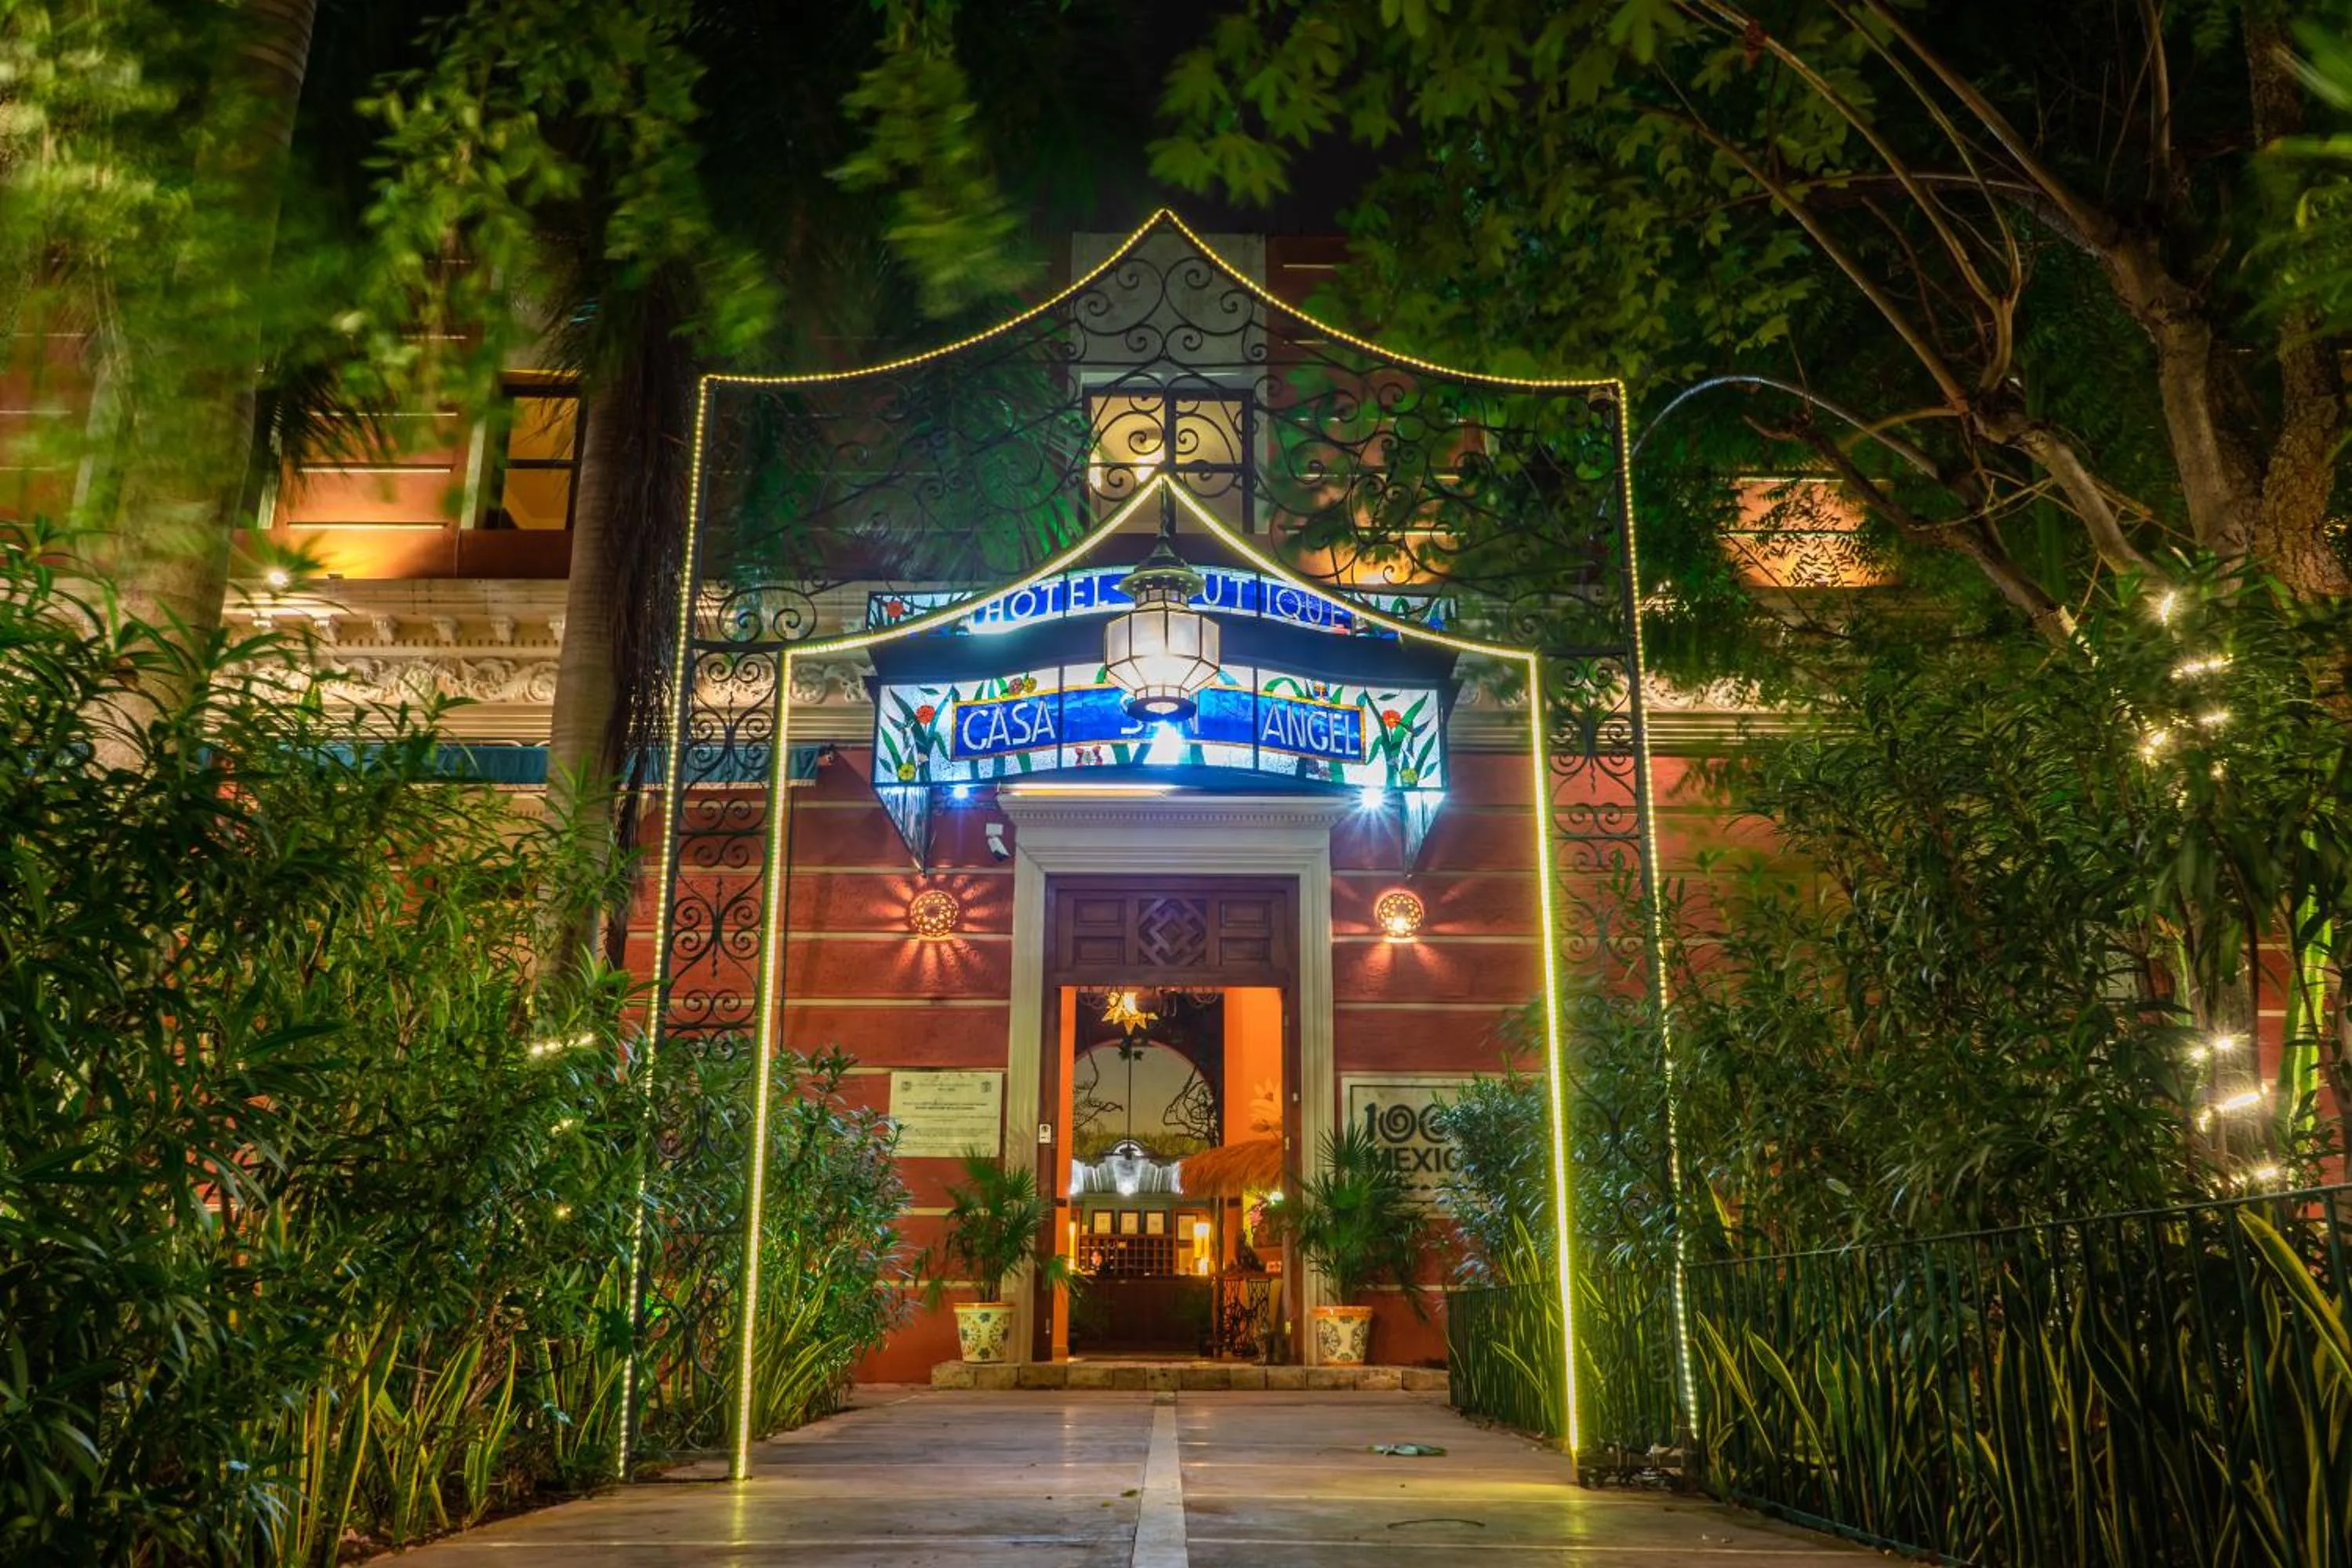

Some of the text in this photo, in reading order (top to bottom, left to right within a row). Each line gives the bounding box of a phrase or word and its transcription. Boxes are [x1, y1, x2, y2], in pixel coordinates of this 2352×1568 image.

[985, 573, 1345, 628] HOTEL UTIQUE
[962, 700, 1056, 750] CASA
[1260, 702, 1359, 755] ANGEL
